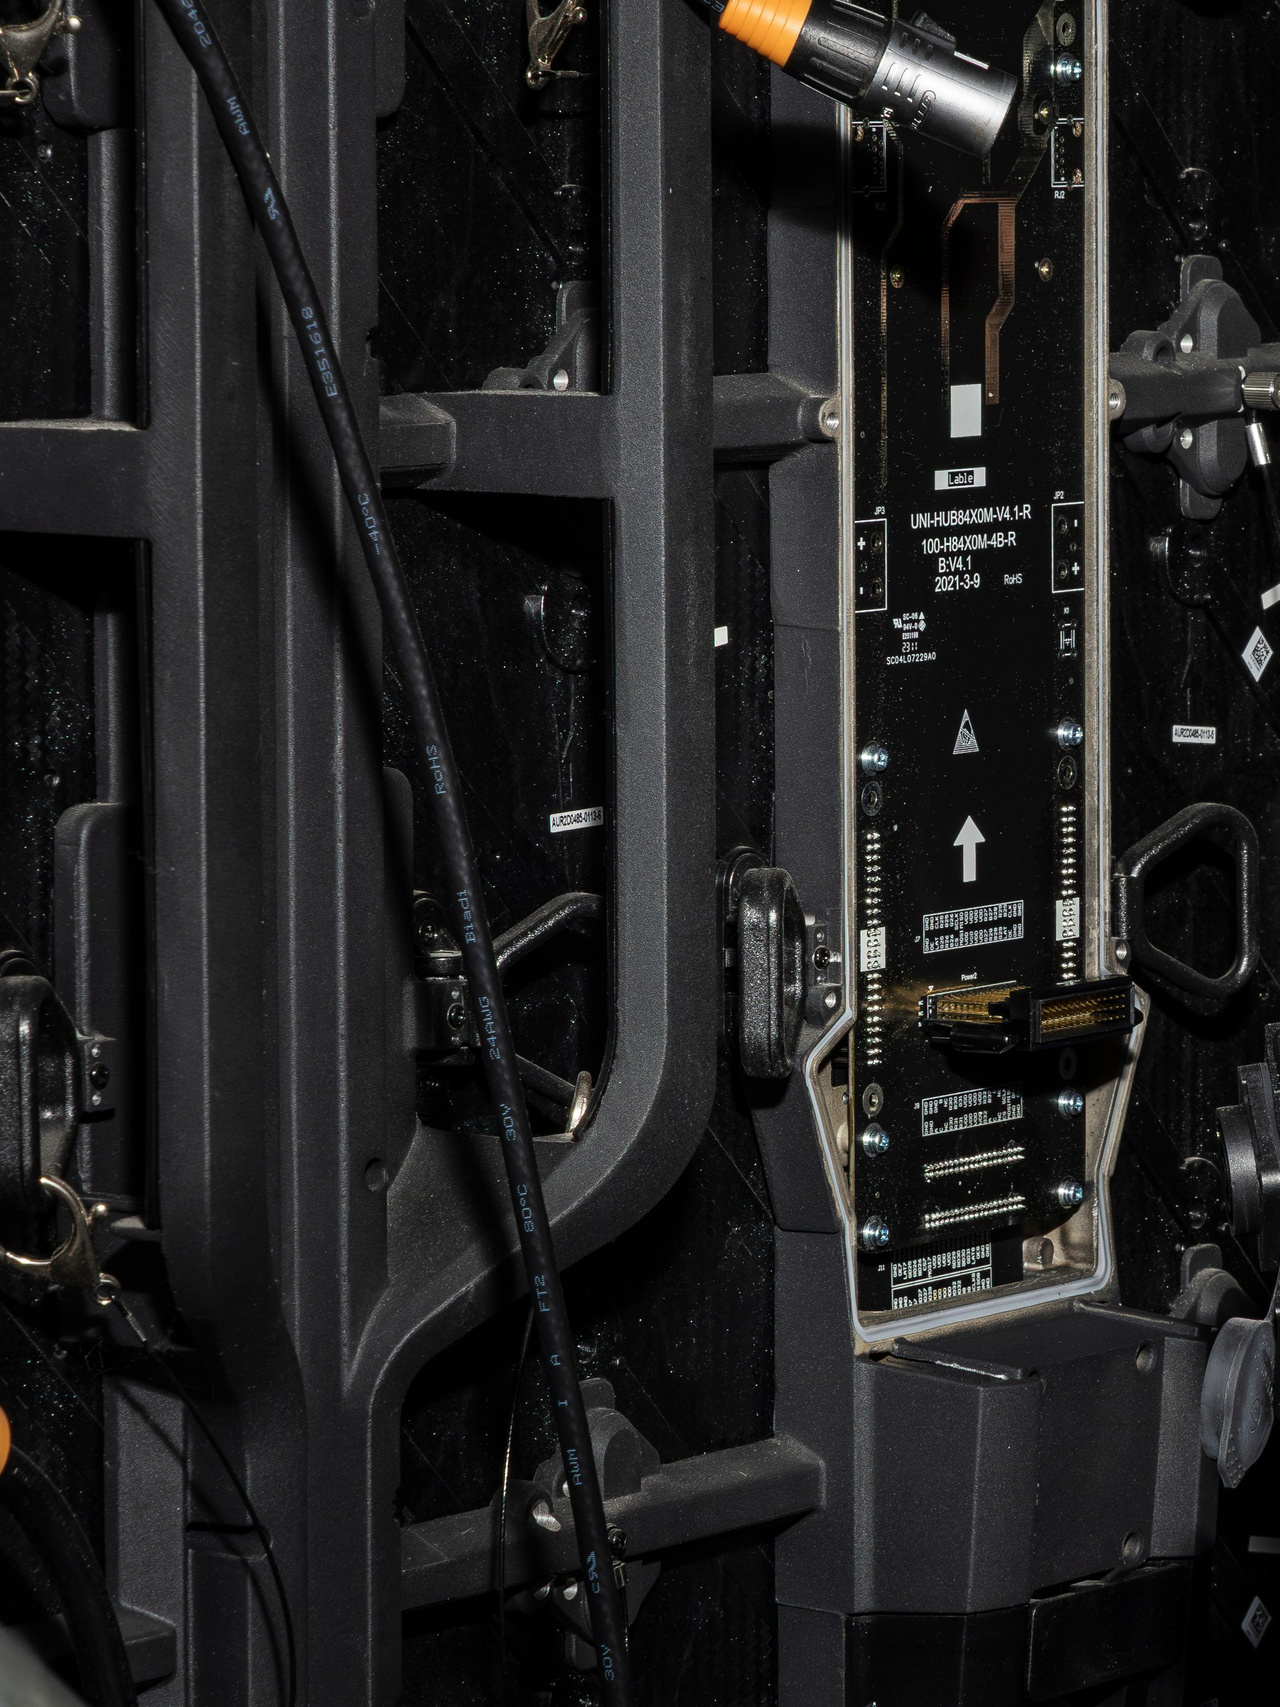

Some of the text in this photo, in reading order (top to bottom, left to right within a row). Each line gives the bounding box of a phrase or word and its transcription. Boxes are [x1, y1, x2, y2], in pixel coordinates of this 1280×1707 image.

[225, 95, 251, 136] AWM
[300, 306, 338, 397] E351618
[948, 470, 974, 486] Lable
[1054, 491, 1064, 499] JP2
[874, 506, 885, 515] JP3
[910, 504, 1031, 529] UNI-HUB84X0M-V4.1-R
[922, 532, 1016, 554] 100-H84X0M-4B-R
[938, 555, 972, 573] B:V4.1
[935, 574, 1023, 592] 2021-3-9 RoHS
[423, 743, 449, 795] RoHS
[478, 995, 501, 1060] 24AWG
[500, 1102, 517, 1141] 30V
[533, 1274, 551, 1312] FT2
[566, 1447, 582, 1486] AWM
[599, 1643, 616, 1680] 30V
